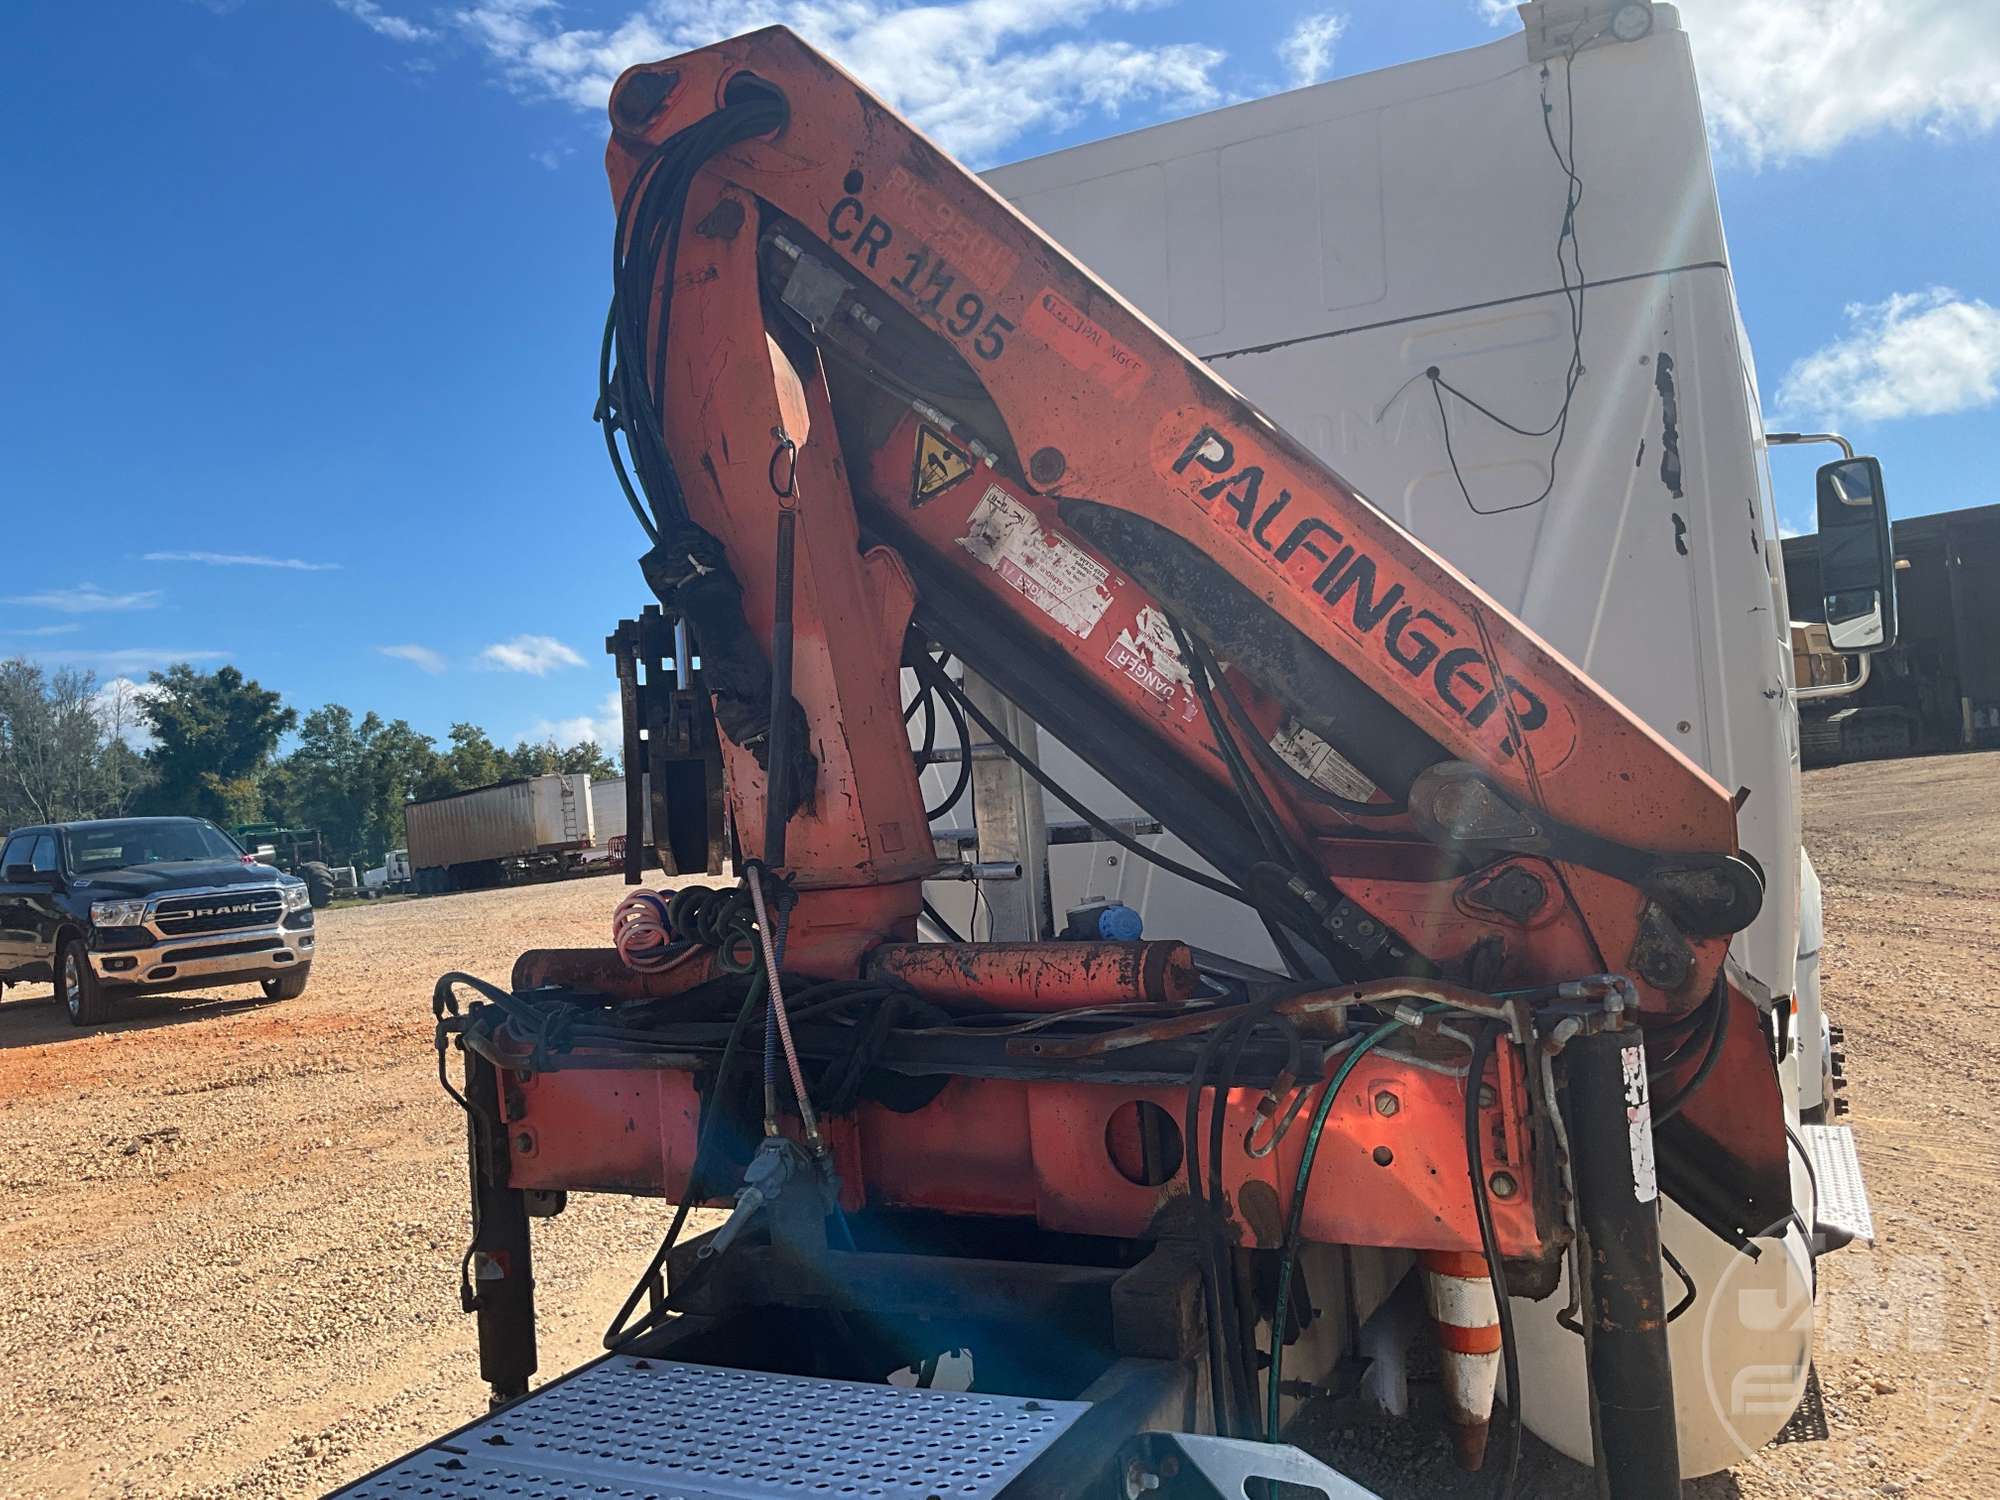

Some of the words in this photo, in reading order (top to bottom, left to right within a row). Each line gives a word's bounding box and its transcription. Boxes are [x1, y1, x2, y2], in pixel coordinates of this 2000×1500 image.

[828, 197, 893, 268] CR
[889, 244, 1017, 361] 1195
[1172, 426, 1548, 757] PALFINGER
[196, 904, 250, 917] RAM
